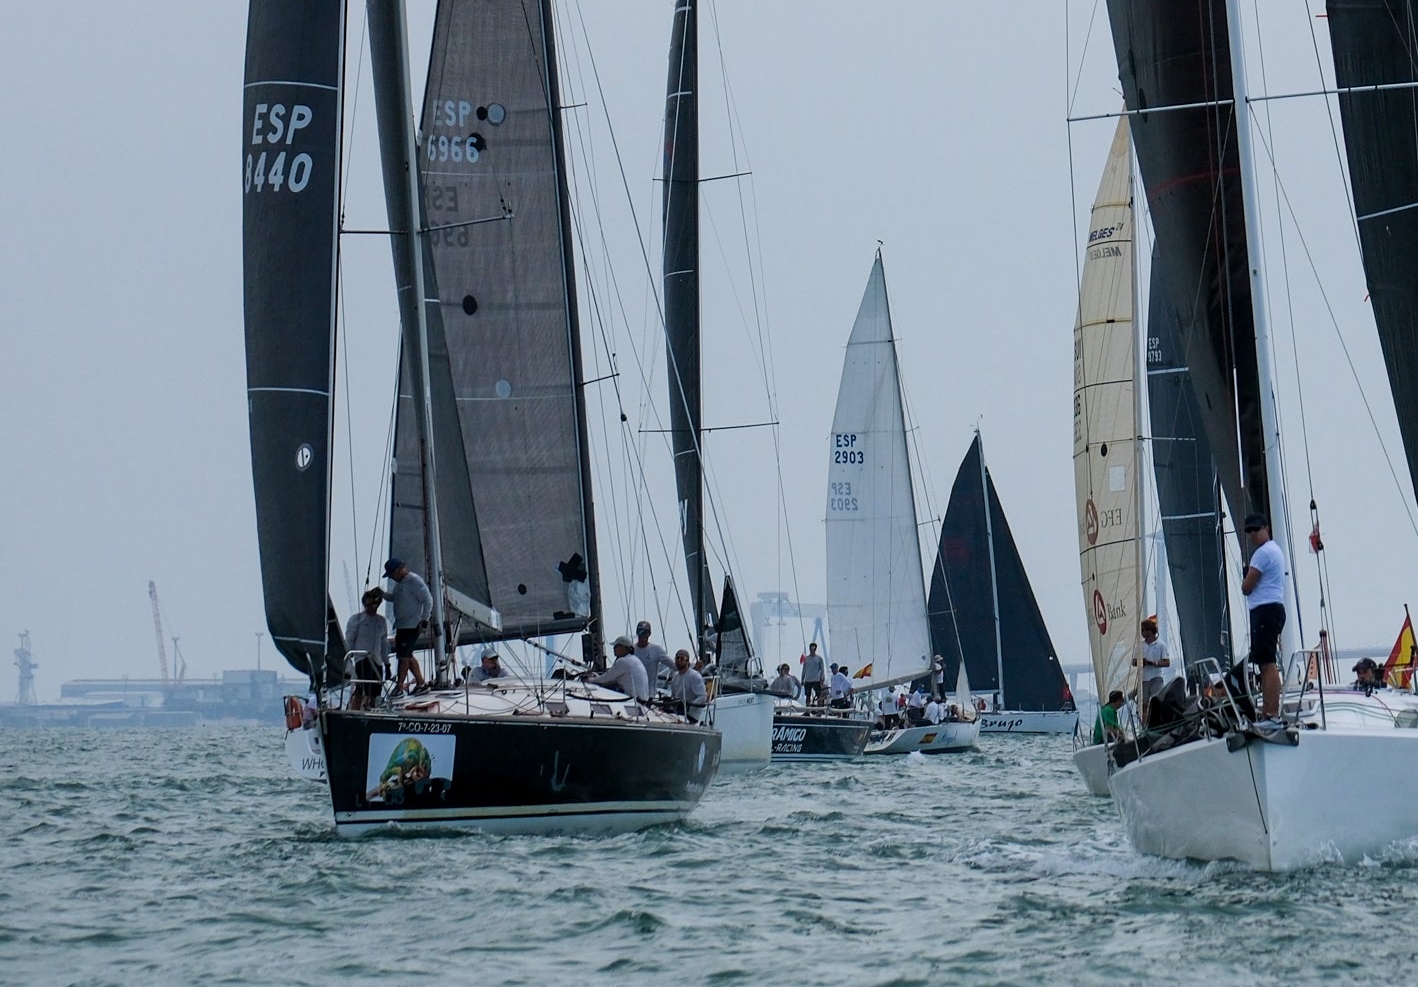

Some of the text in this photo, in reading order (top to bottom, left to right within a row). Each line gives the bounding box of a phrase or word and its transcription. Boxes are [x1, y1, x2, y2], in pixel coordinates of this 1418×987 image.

[433, 99, 471, 127] ESP
[252, 103, 313, 145] ESP
[427, 134, 479, 163] 6966
[1149, 337, 1160, 349] ESP
[836, 434, 857, 447] ESP
[835, 450, 864, 464] 2903
[1107, 600, 1127, 620] Bank
